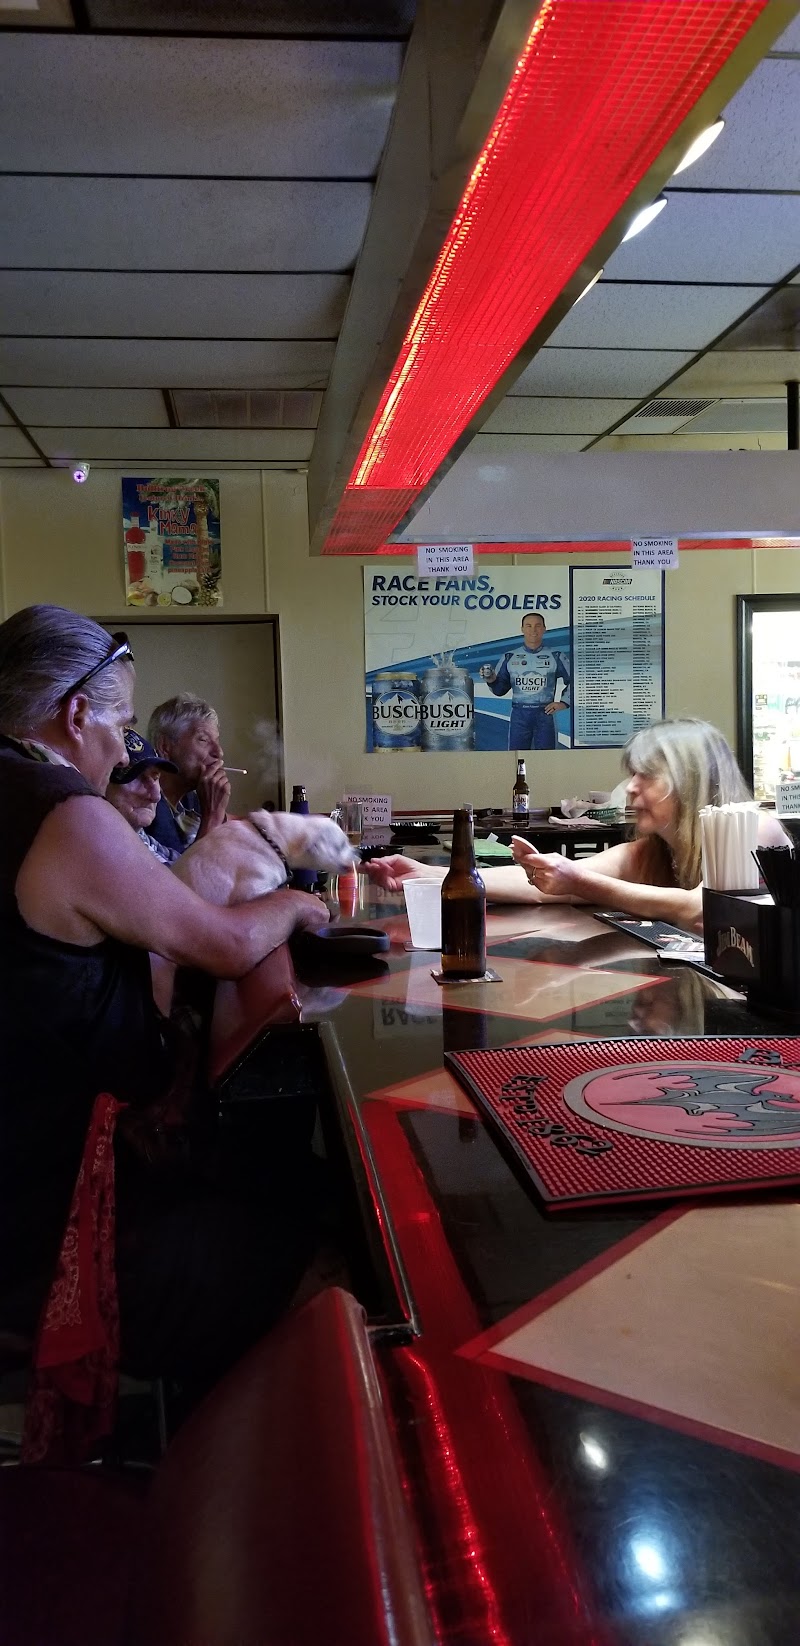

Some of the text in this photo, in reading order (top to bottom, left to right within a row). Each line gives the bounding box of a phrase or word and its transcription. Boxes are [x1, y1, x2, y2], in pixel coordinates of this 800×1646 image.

[147, 505, 191, 525] Kinky
[159, 520, 197, 536] Mama
[371, 575, 495, 594] RACE FANS,
[371, 593, 562, 610] STOCK YOUR COOLERS
[515, 677, 547, 686] BUSCH
[372, 705, 421, 720] BUSCH
[420, 704, 474, 719] BUSCH
[729, 926, 756, 968] BEAM
[515, 1117, 614, 1155] 1862
